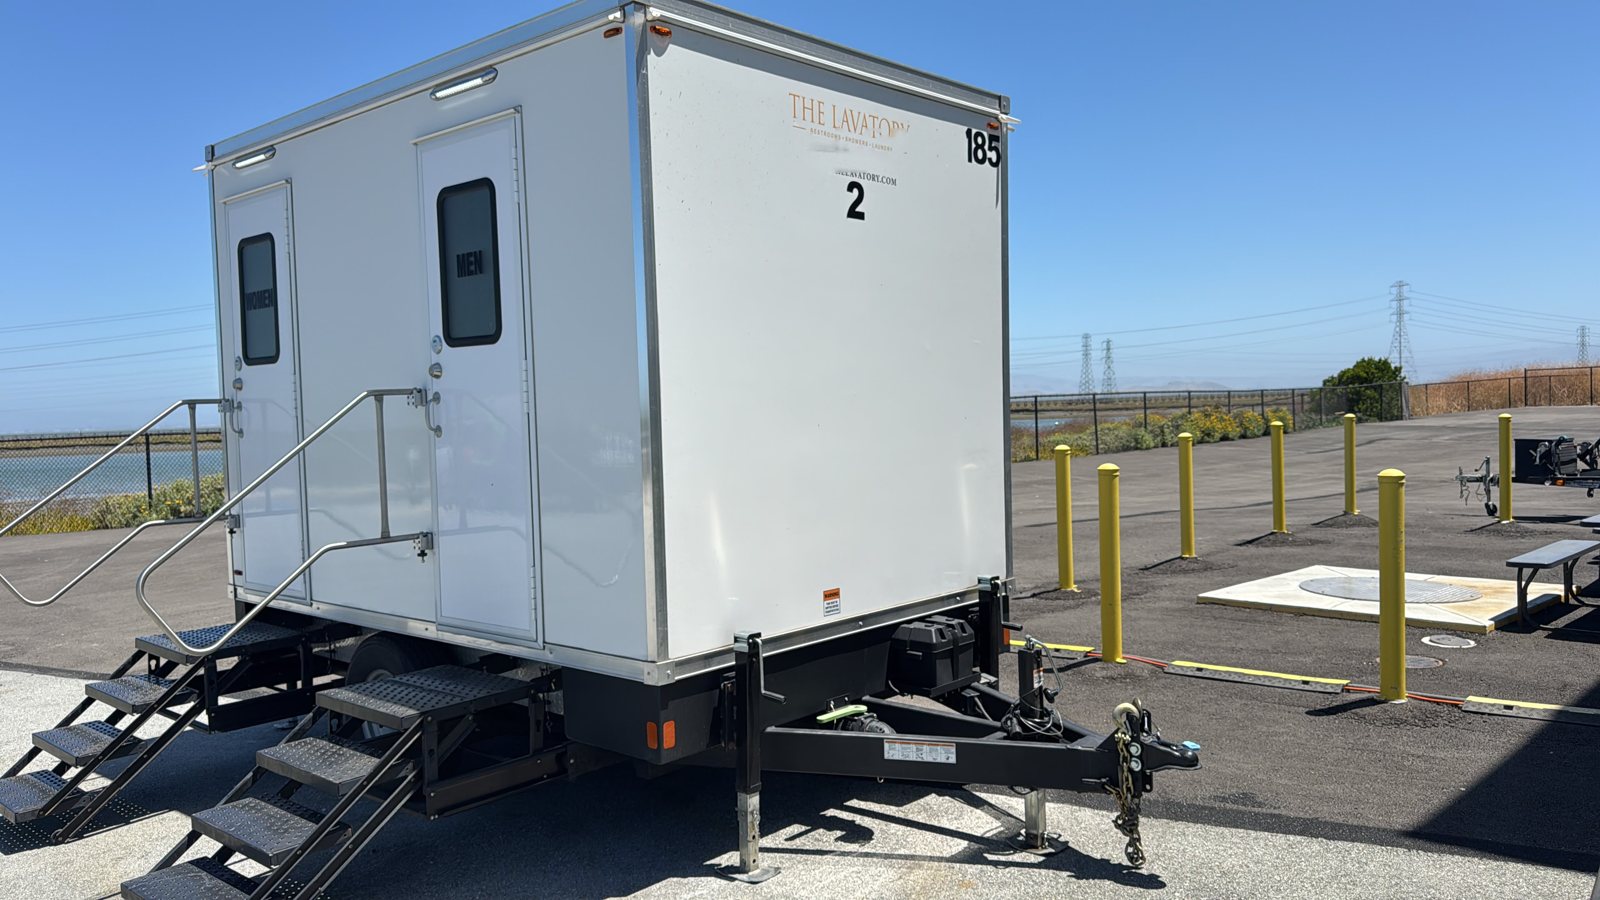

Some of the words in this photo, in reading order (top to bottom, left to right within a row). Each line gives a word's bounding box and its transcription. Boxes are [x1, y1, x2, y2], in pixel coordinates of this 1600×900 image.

[788, 93, 825, 126] THE
[965, 128, 1001, 168] 185
[846, 181, 865, 221] 2
[456, 250, 483, 278] MEN
[245, 288, 274, 311] WOMEN
